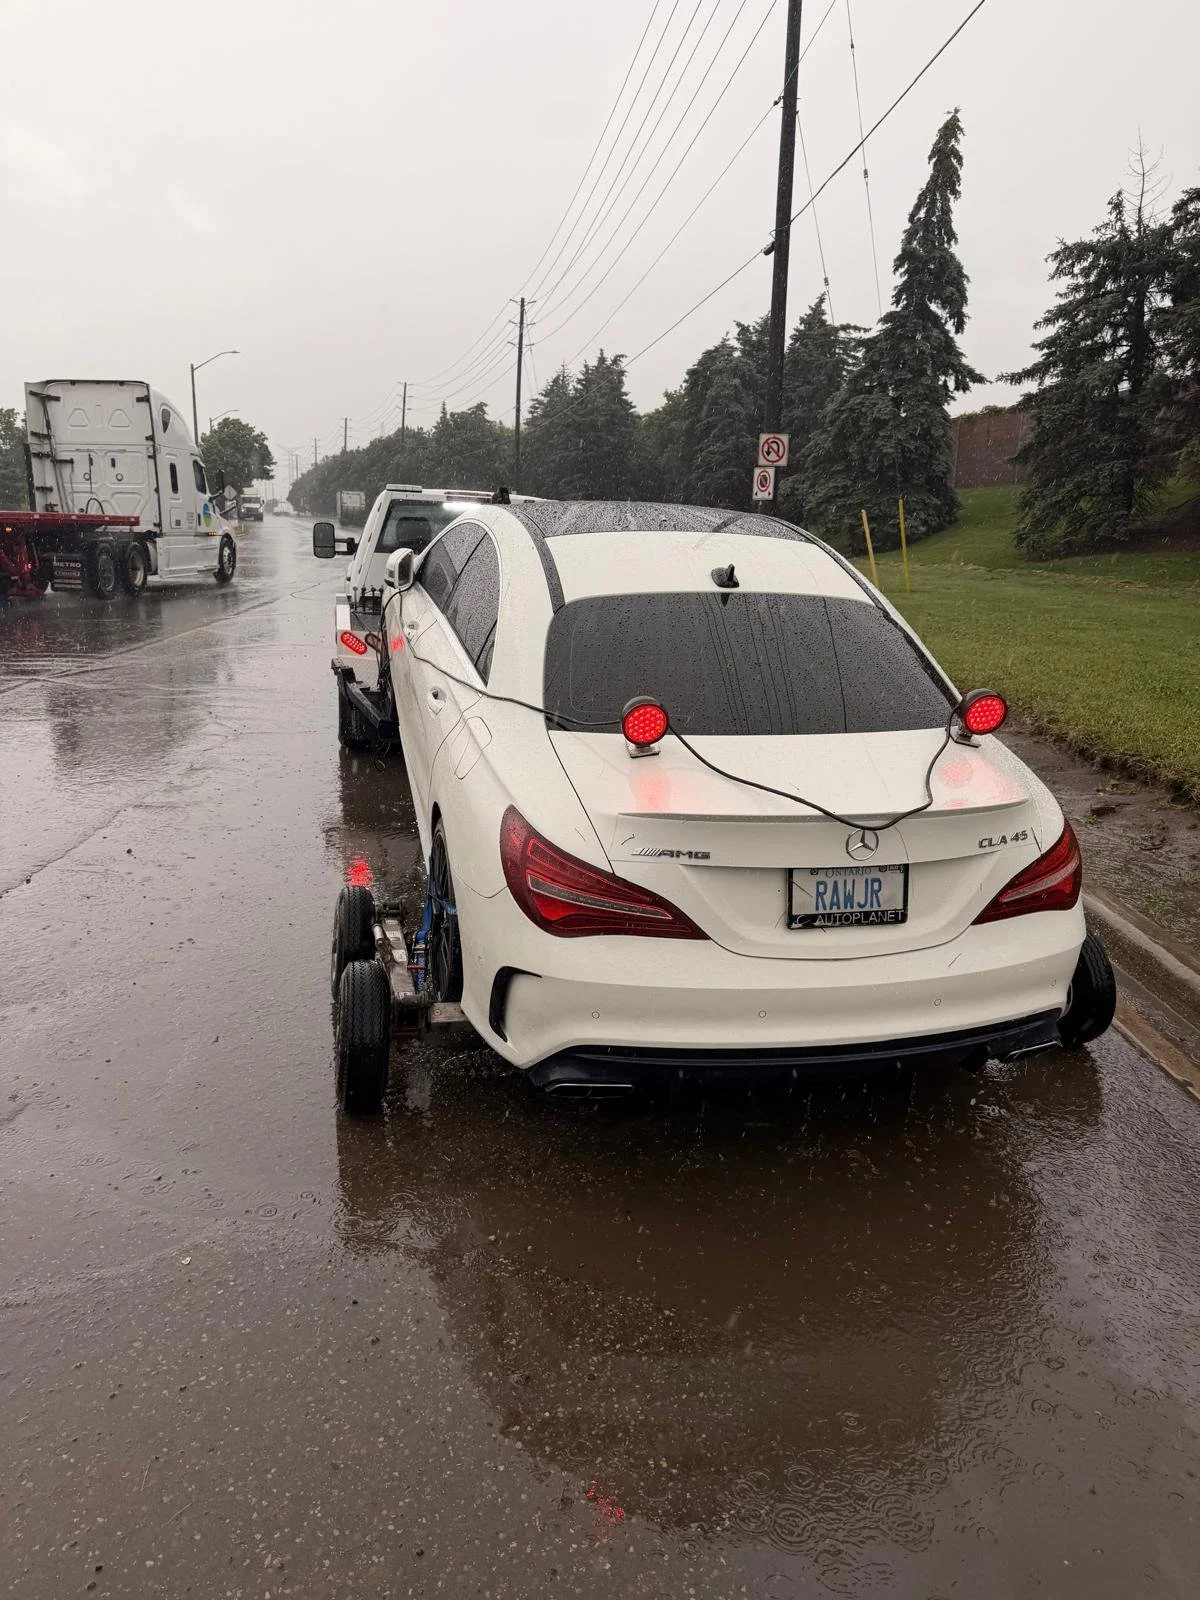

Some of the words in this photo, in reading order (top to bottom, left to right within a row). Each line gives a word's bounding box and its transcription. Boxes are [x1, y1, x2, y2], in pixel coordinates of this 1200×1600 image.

[978, 834, 1008, 849] CLA
[1010, 829, 1028, 842] 45
[658, 848, 711, 860] AMG
[825, 866, 872, 879] ONTARIO
[815, 877, 882, 911] RAWJR
[815, 909, 905, 926] AUTOPLANET
